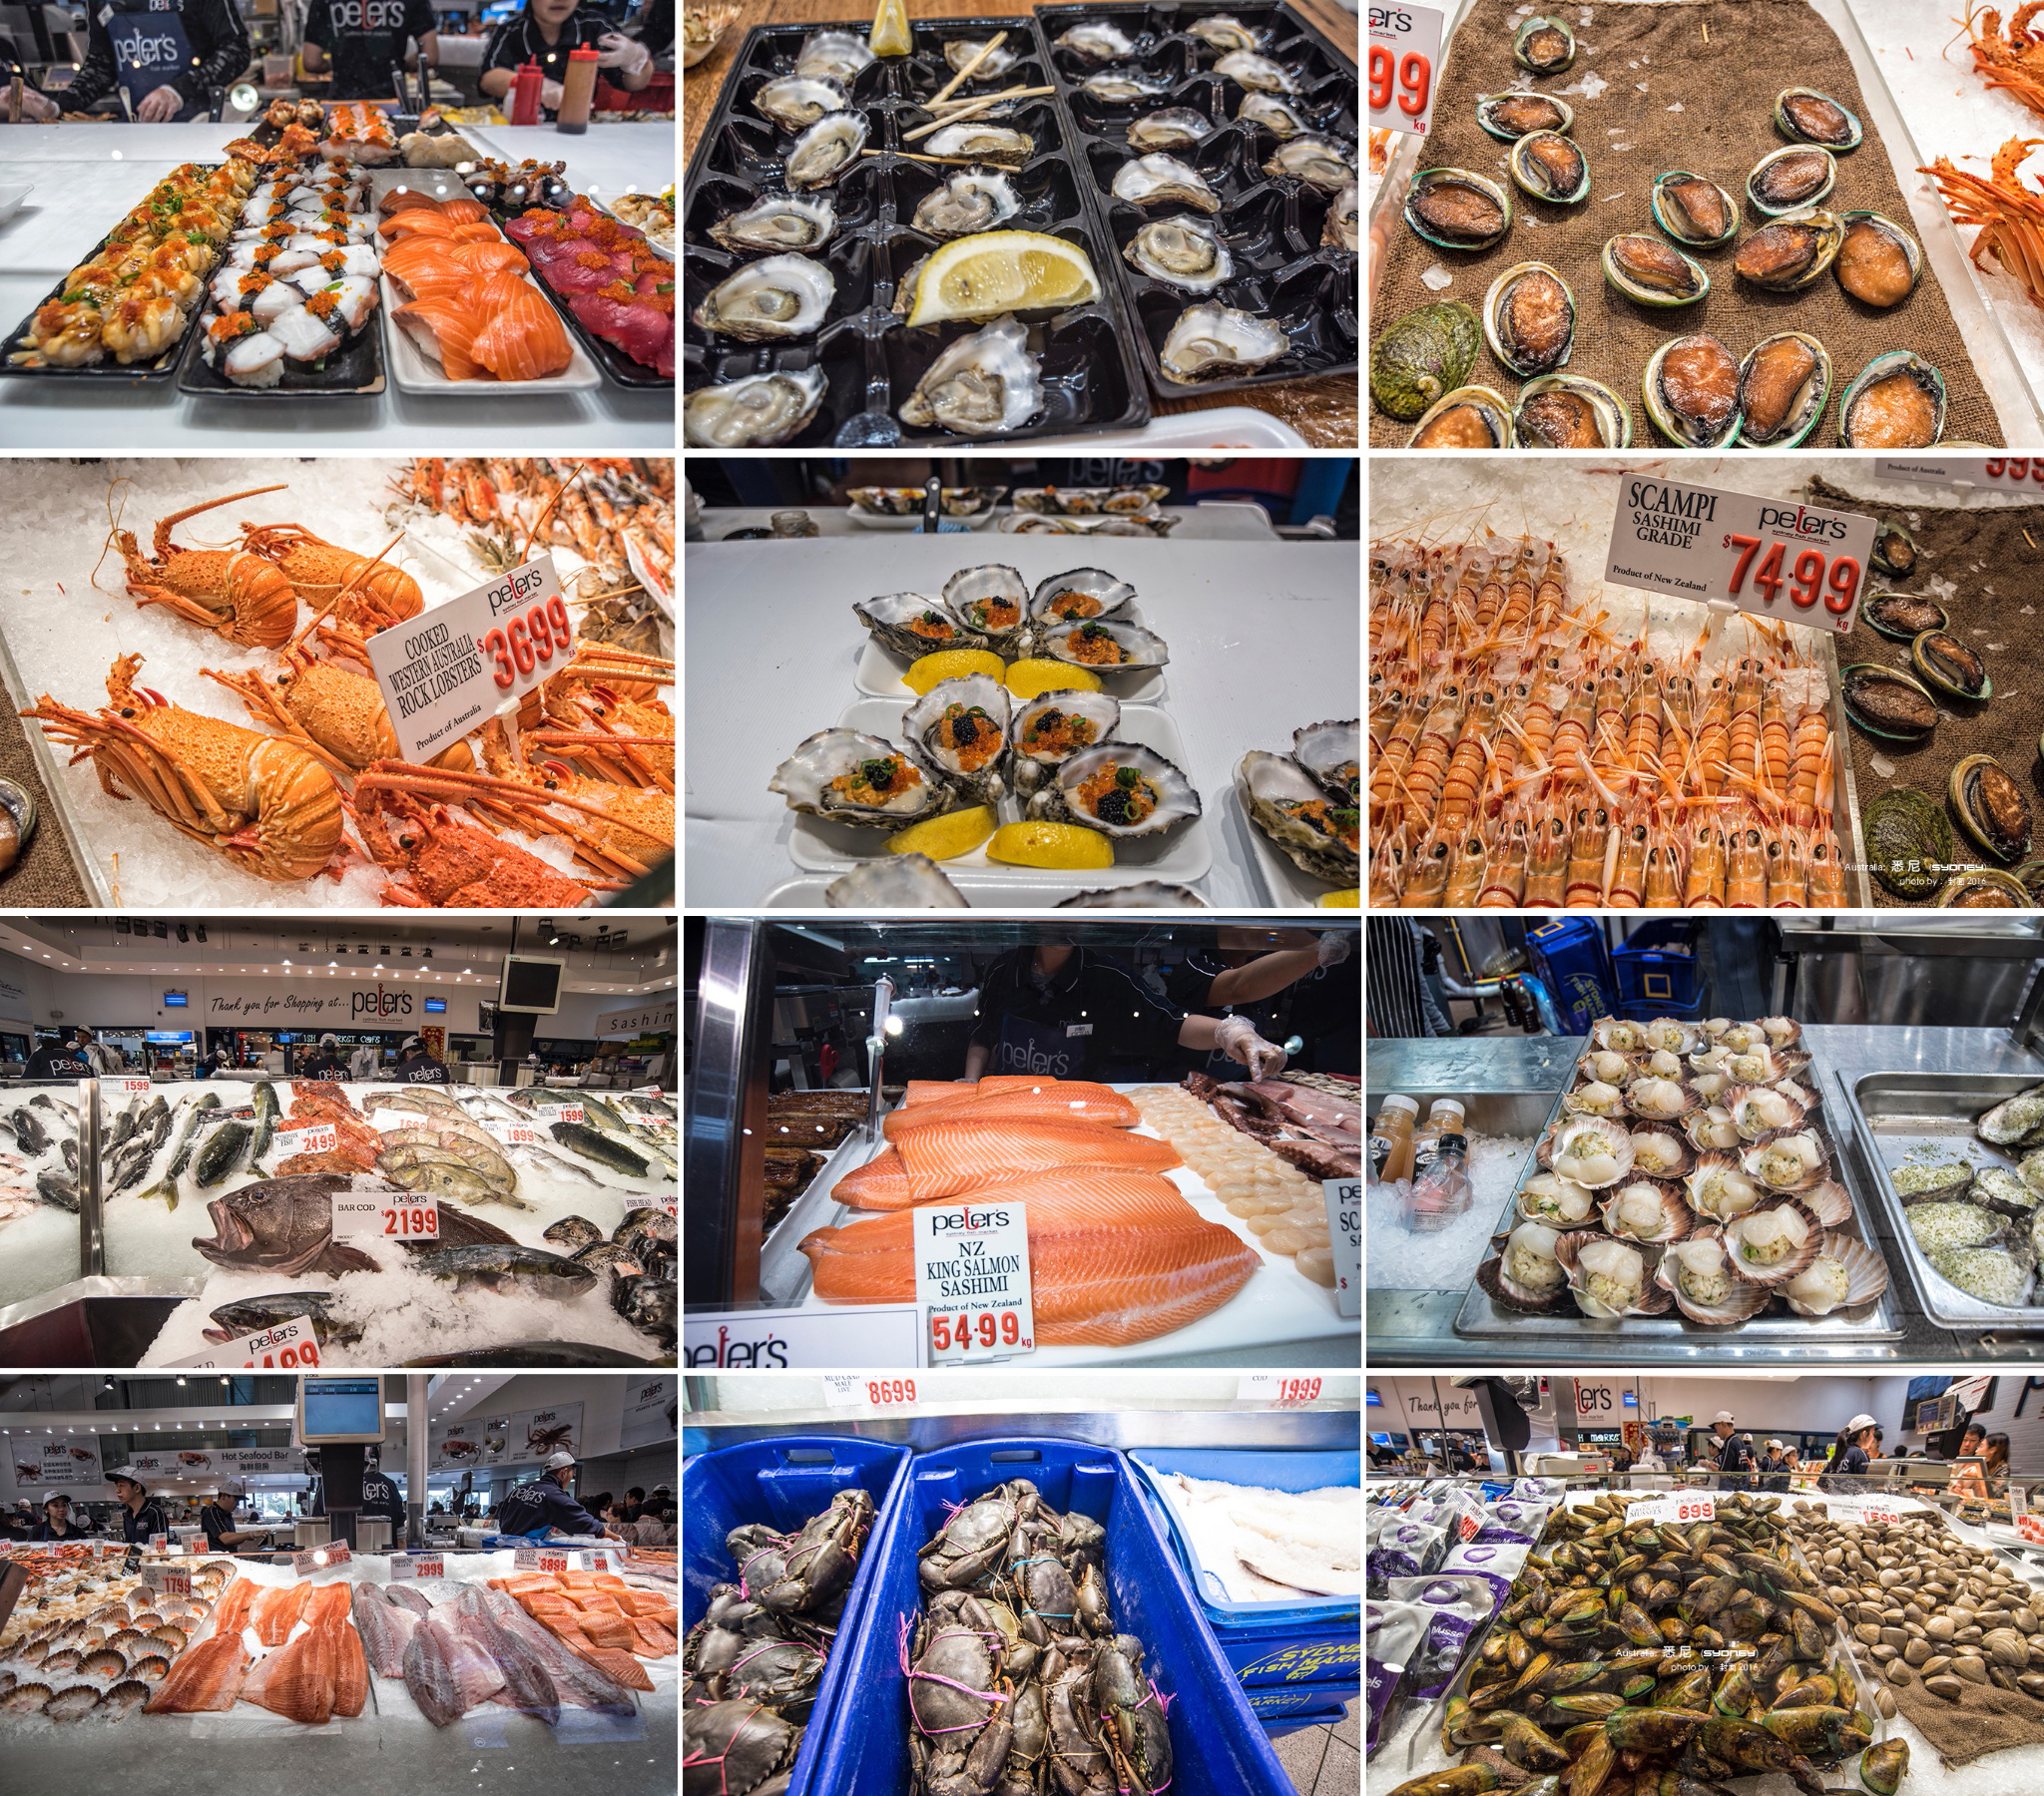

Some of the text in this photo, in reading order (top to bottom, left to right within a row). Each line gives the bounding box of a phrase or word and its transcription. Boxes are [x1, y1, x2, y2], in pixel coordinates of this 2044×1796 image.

[1413, 119, 1426, 134] kg
[1887, 463, 1910, 472] Product
[1919, 465, 1945, 476] Australia
[1628, 481, 1719, 522] SCAMPI
[1632, 511, 1702, 536] SASHIMI
[1759, 506, 1847, 540] peter's
[1637, 527, 1693, 549] GRADE
[1773, 530, 1794, 539] sydney
[1613, 565, 1707, 592] Product of New Zealand
[487, 569, 543, 617] peter's
[1835, 618, 1849, 631] kg
[404, 623, 449, 660] COOKED
[389, 633, 476, 695] WESTERN AUSTRALIA
[569, 650, 576, 659] EA
[396, 654, 482, 718] ROCK LOBSTERS
[415, 704, 482, 750] Product of Australia
[211, 998, 241, 1012] Thank
[243, 1001, 260, 1016] you
[263, 998, 279, 1013] for
[283, 994, 324, 1013] Shopping
[351, 983, 412, 1021] peter's
[1002, 1038, 1069, 1076] peter's
[280, 1137, 293, 1147] FISH
[932, 1206, 1010, 1236] peter's
[958, 1241, 985, 1257] NZ
[926, 1255, 1020, 1280] KING SALMON
[941, 1275, 1009, 1297] SASHIMI
[991, 1298, 1022, 1307] Zealand
[250, 1325, 298, 1355] peter's
[1021, 1337, 1032, 1348] kg
[1408, 1396, 1440, 1413] Thank
[1443, 1399, 1461, 1416] you
[222, 1451, 289, 1461] Hot Seafood Bar
[1630, 1509, 1662, 1518] MUSSELS
[1244, 1660, 1297, 1678] FISH
